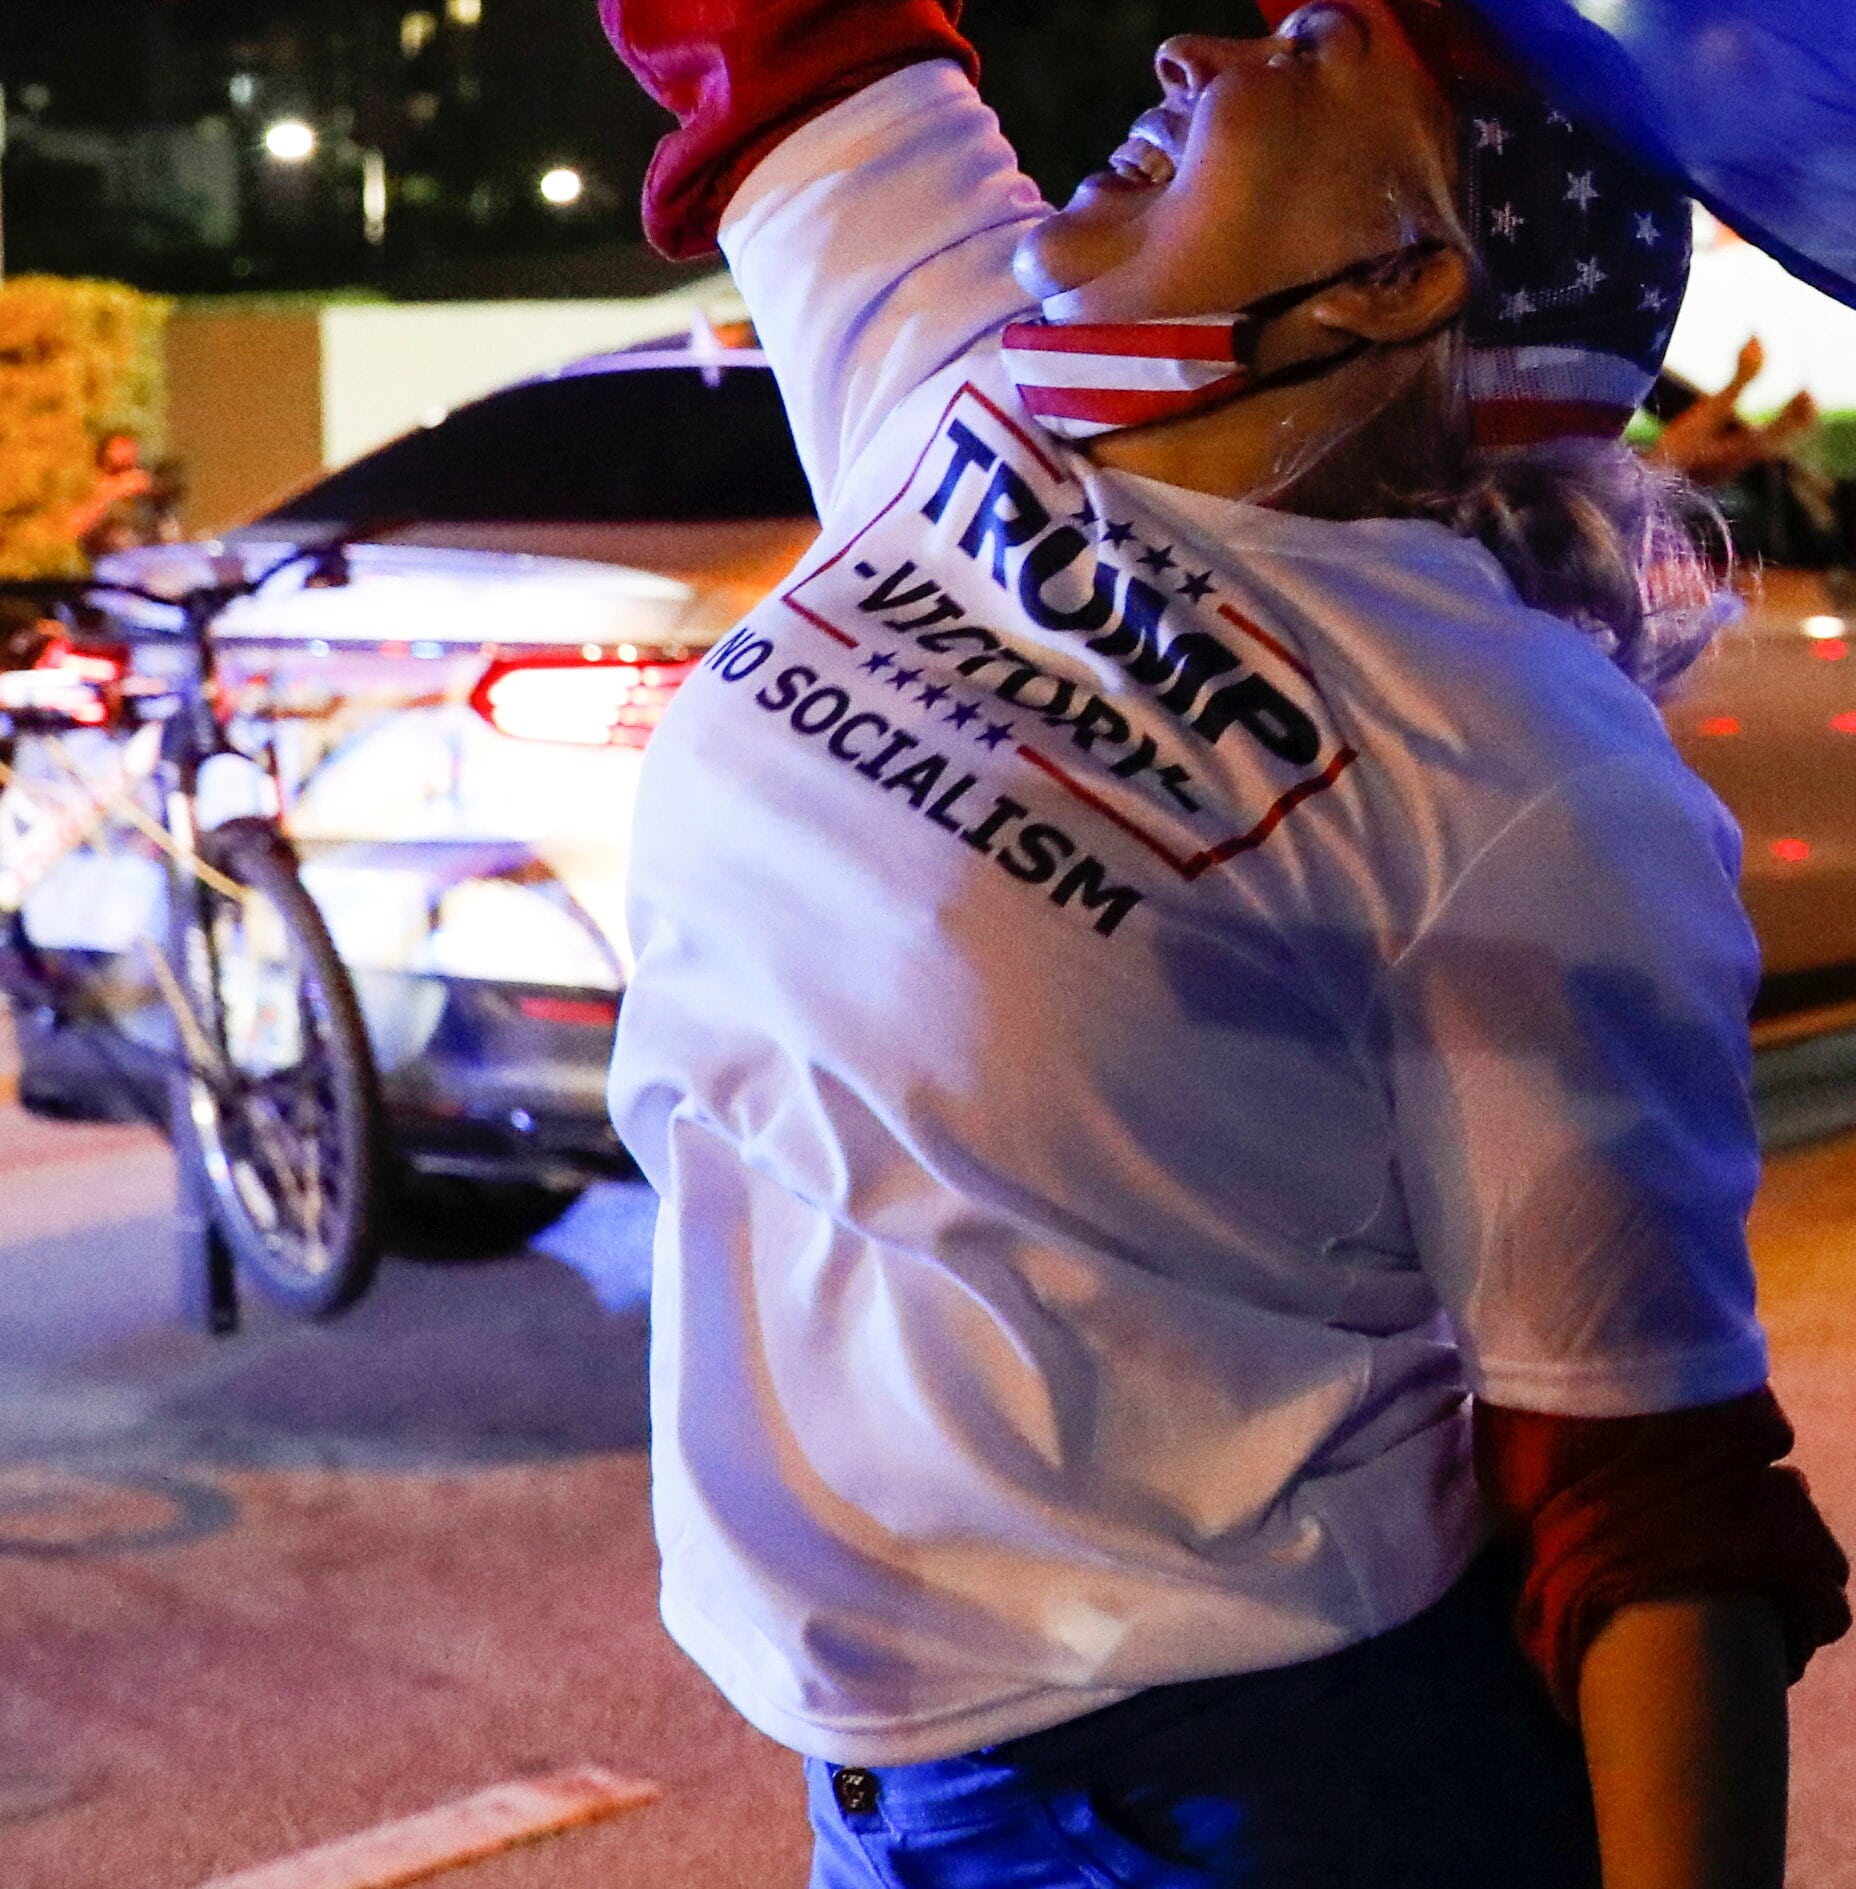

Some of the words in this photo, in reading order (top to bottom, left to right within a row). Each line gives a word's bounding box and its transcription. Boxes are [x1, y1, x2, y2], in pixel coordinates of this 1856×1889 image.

[922, 418, 1320, 766] TRUMP
[705, 628, 774, 684] NO
[756, 663, 1145, 939] SOCIALISM
